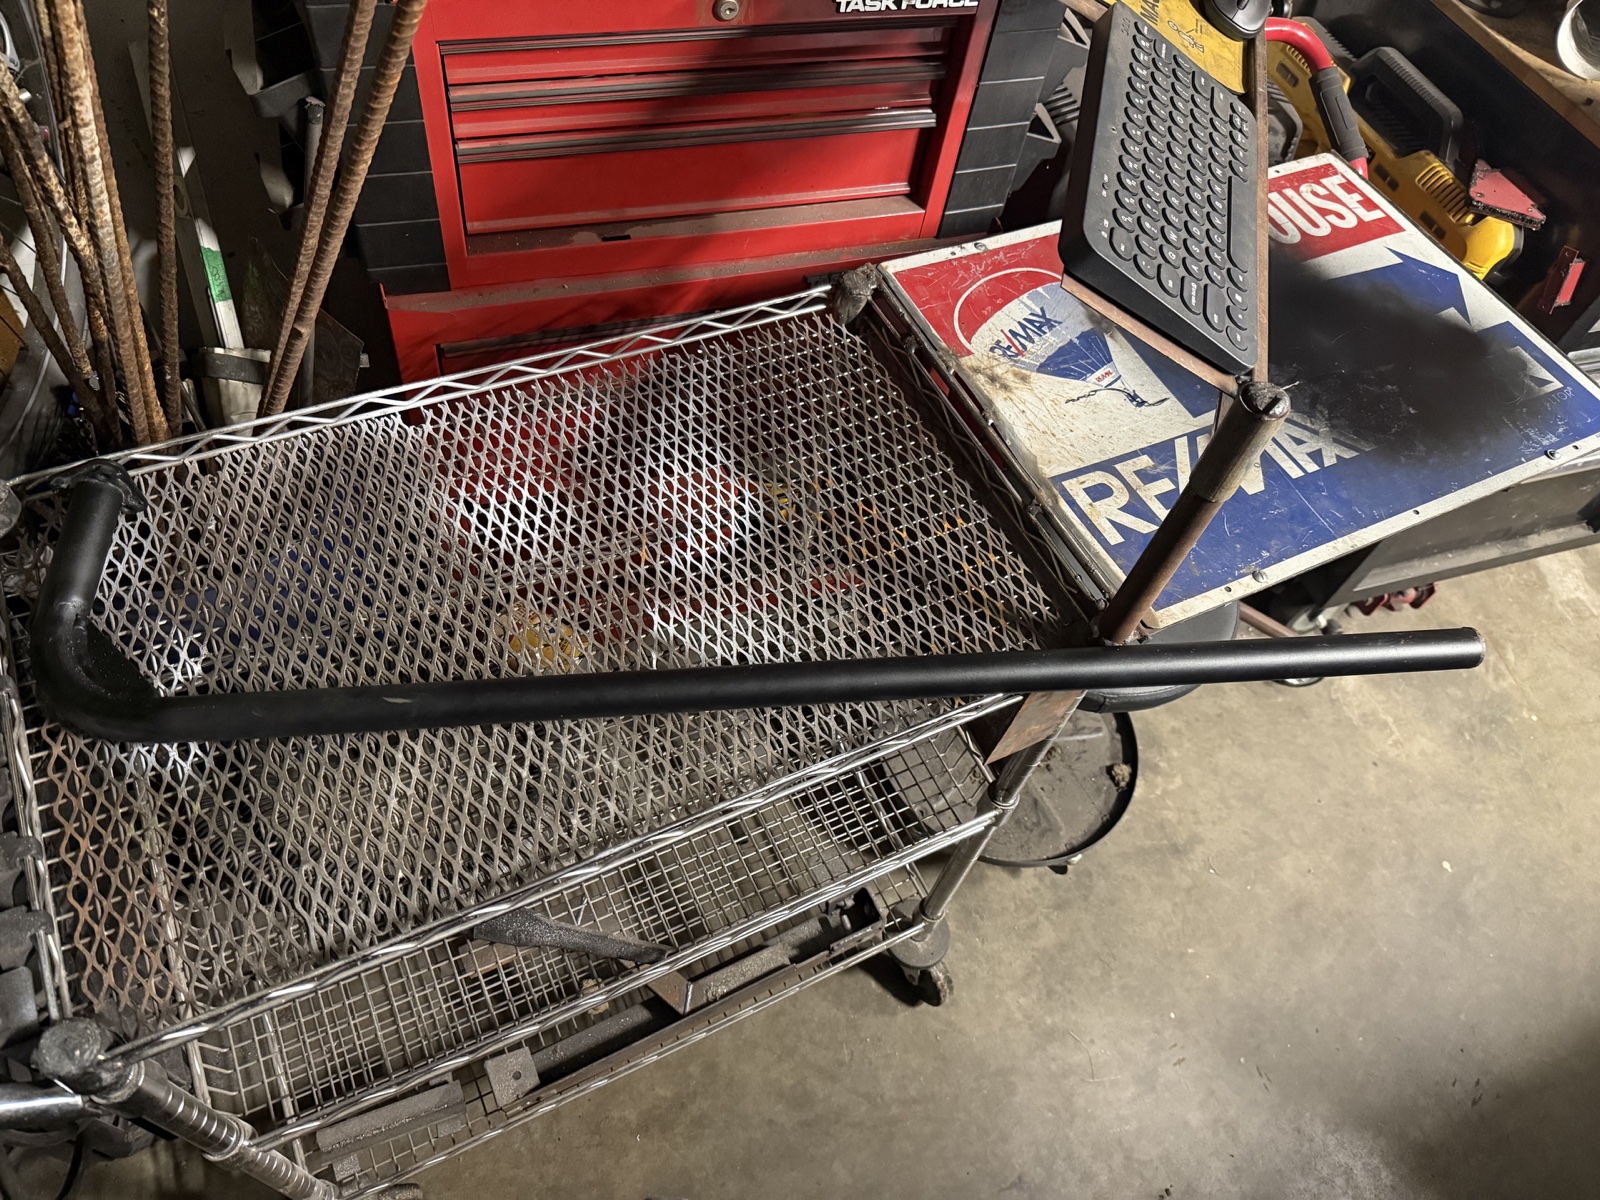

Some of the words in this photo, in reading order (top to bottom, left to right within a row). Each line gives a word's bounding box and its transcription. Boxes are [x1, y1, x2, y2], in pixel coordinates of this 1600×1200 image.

[836, 0, 898, 13] TASK
[1267, 174, 1387, 245] OUSE
[989, 306, 1064, 358] RE/MAX
